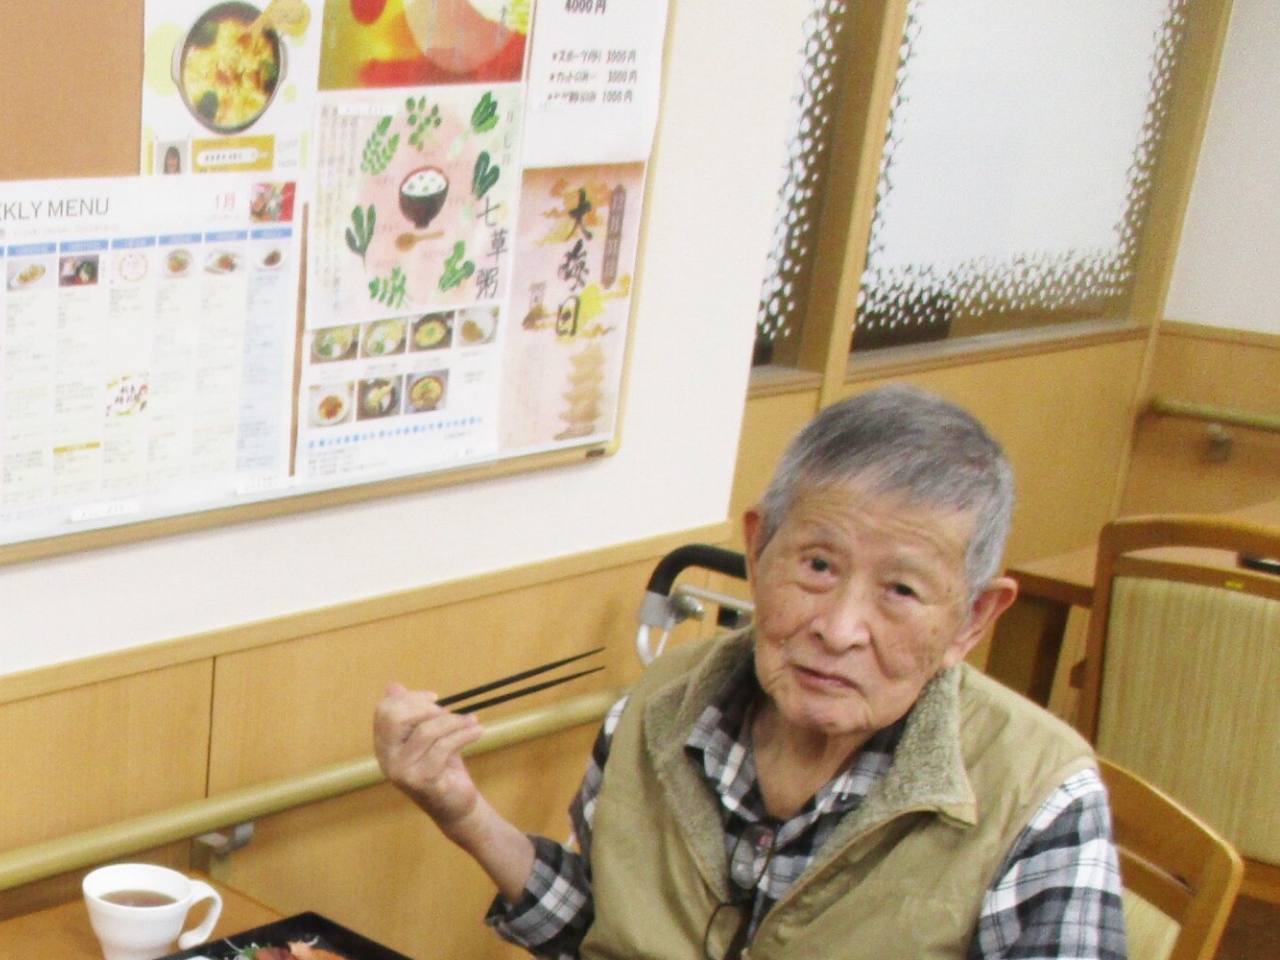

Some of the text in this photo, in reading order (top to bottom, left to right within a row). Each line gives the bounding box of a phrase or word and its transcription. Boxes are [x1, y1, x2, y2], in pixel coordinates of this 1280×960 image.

[47, 197, 110, 218] MENU
[214, 193, 236, 211] 1月
[475, 196, 510, 301] 七草粥
